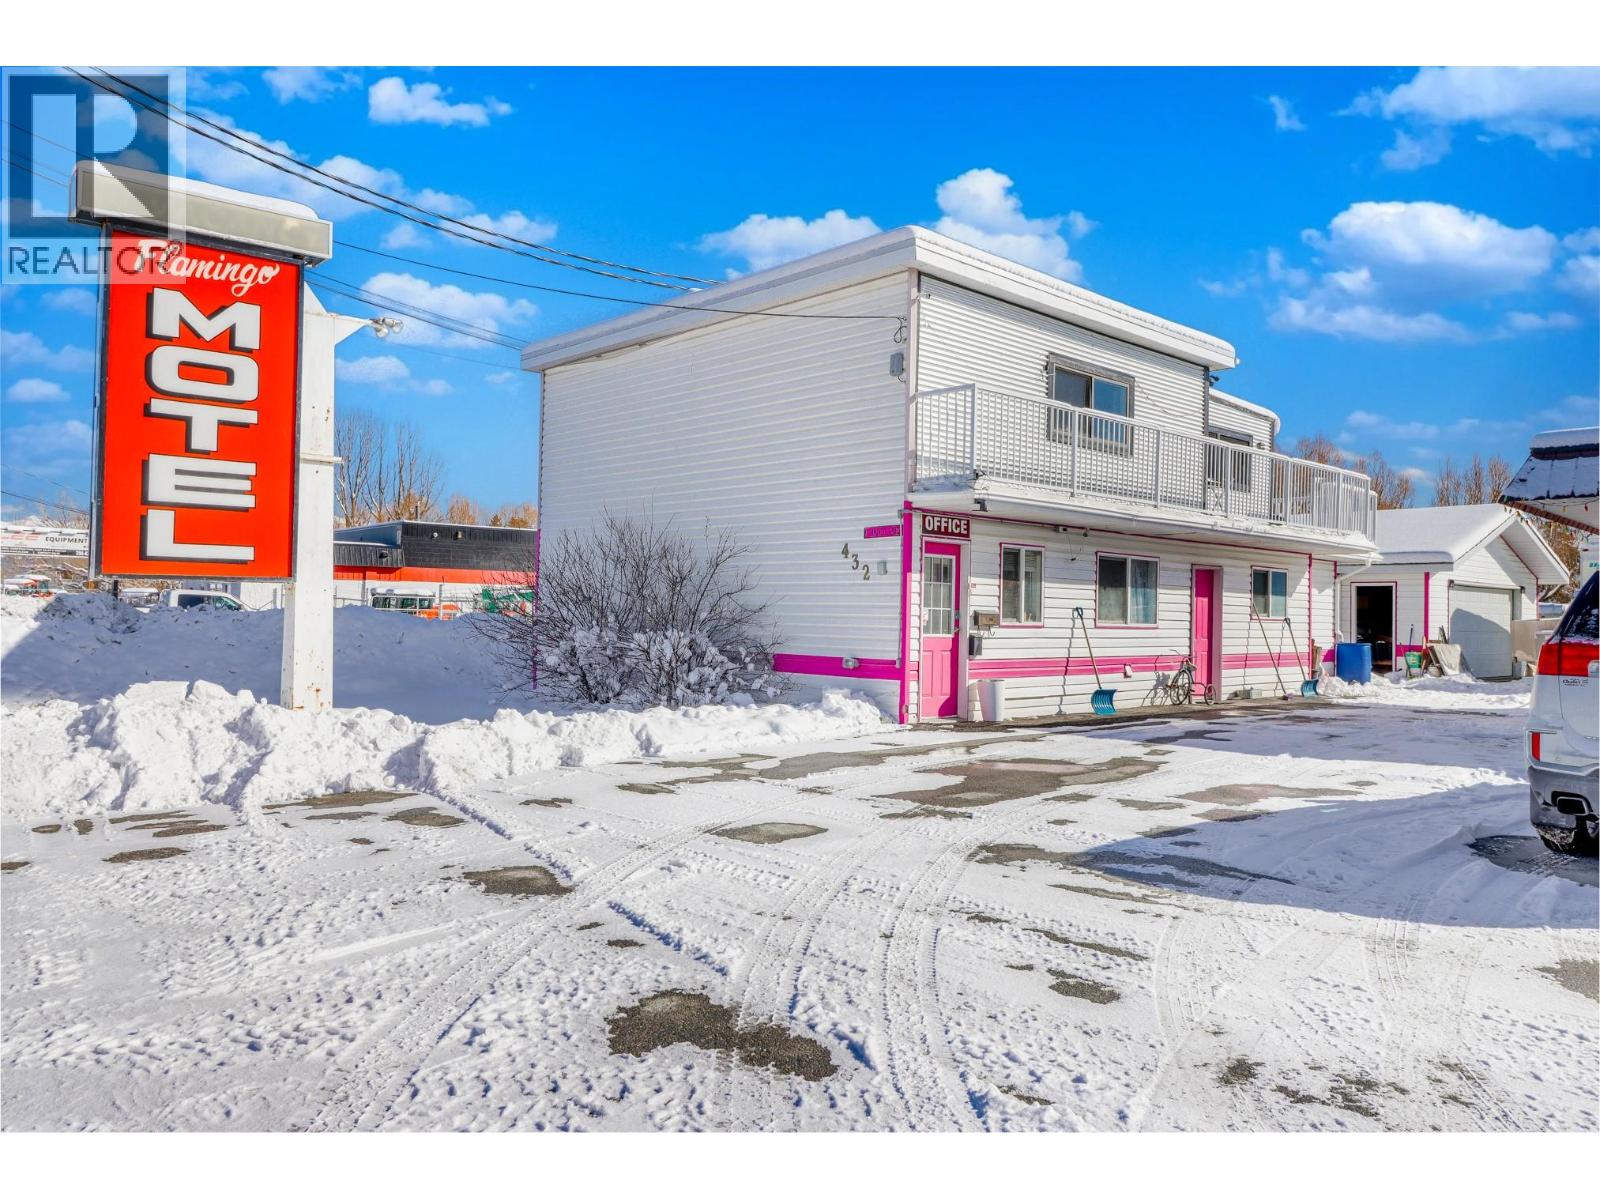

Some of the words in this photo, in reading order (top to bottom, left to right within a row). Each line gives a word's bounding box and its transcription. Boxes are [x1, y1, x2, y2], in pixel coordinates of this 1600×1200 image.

[134, 239, 280, 297] Flamingo
[140, 287, 260, 564] MOTEL
[45, 536, 89, 544] EQUIPMENT
[925, 516, 969, 535] OFFICE
[841, 543, 871, 581] 432
